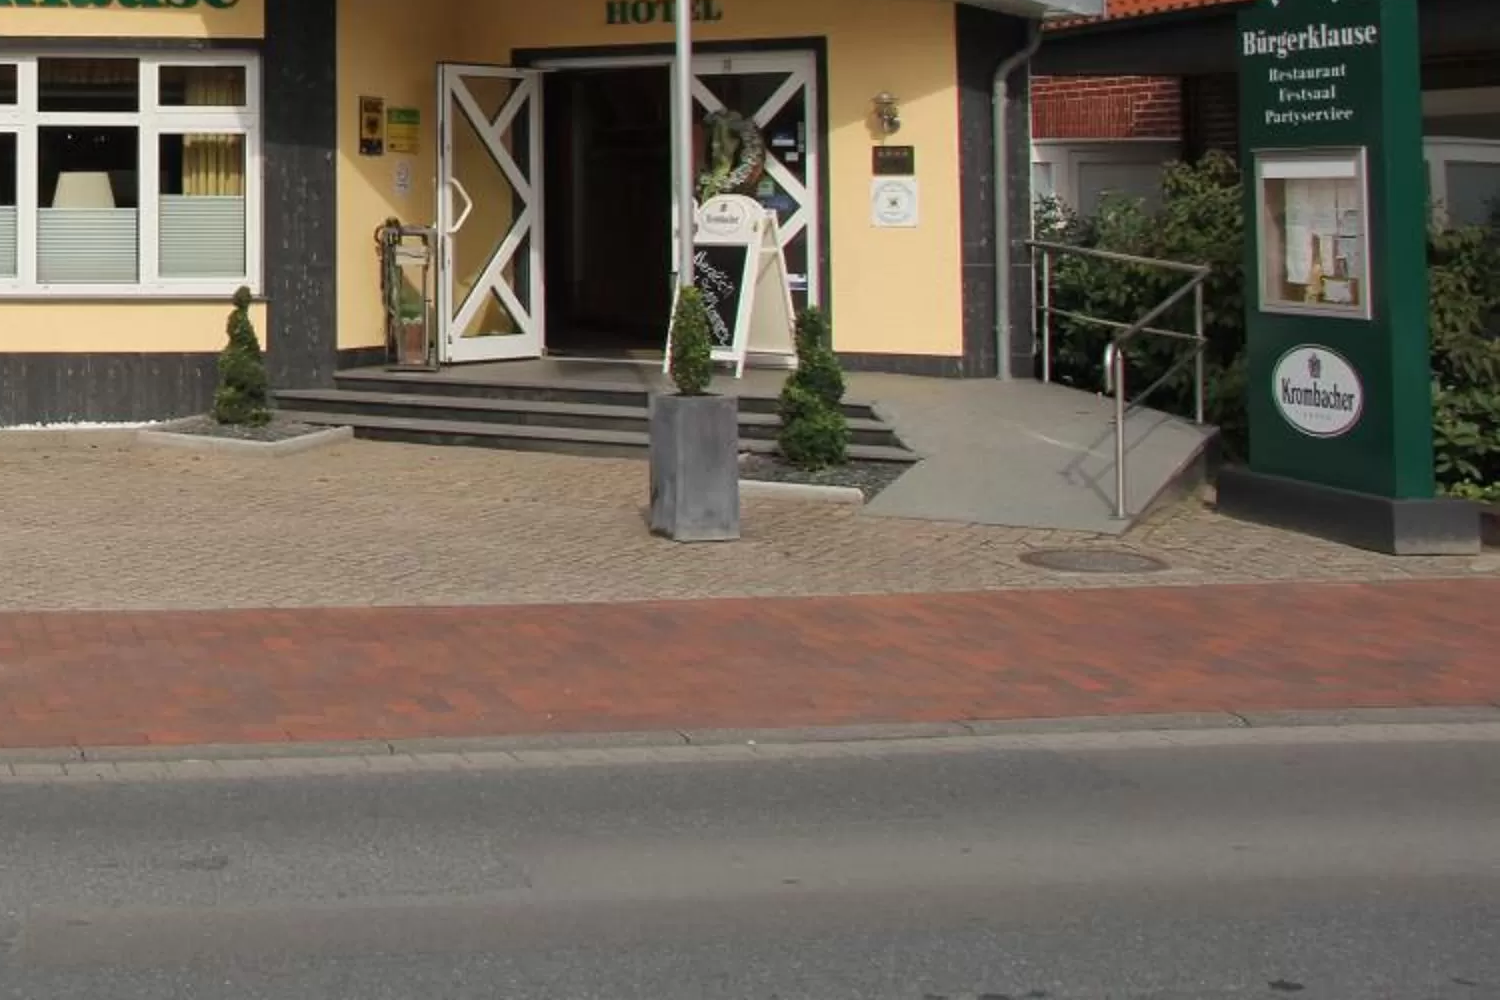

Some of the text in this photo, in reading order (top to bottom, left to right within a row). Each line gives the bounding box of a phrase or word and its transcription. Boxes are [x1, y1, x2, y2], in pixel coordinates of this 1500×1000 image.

[1242, 23, 1378, 59] Bürgerklause
[1268, 62, 1348, 83] Restaurant
[1278, 84, 1337, 102] Festsaal
[1264, 105, 1354, 126] Partyservice
[1281, 377, 1356, 412] Krombacher
